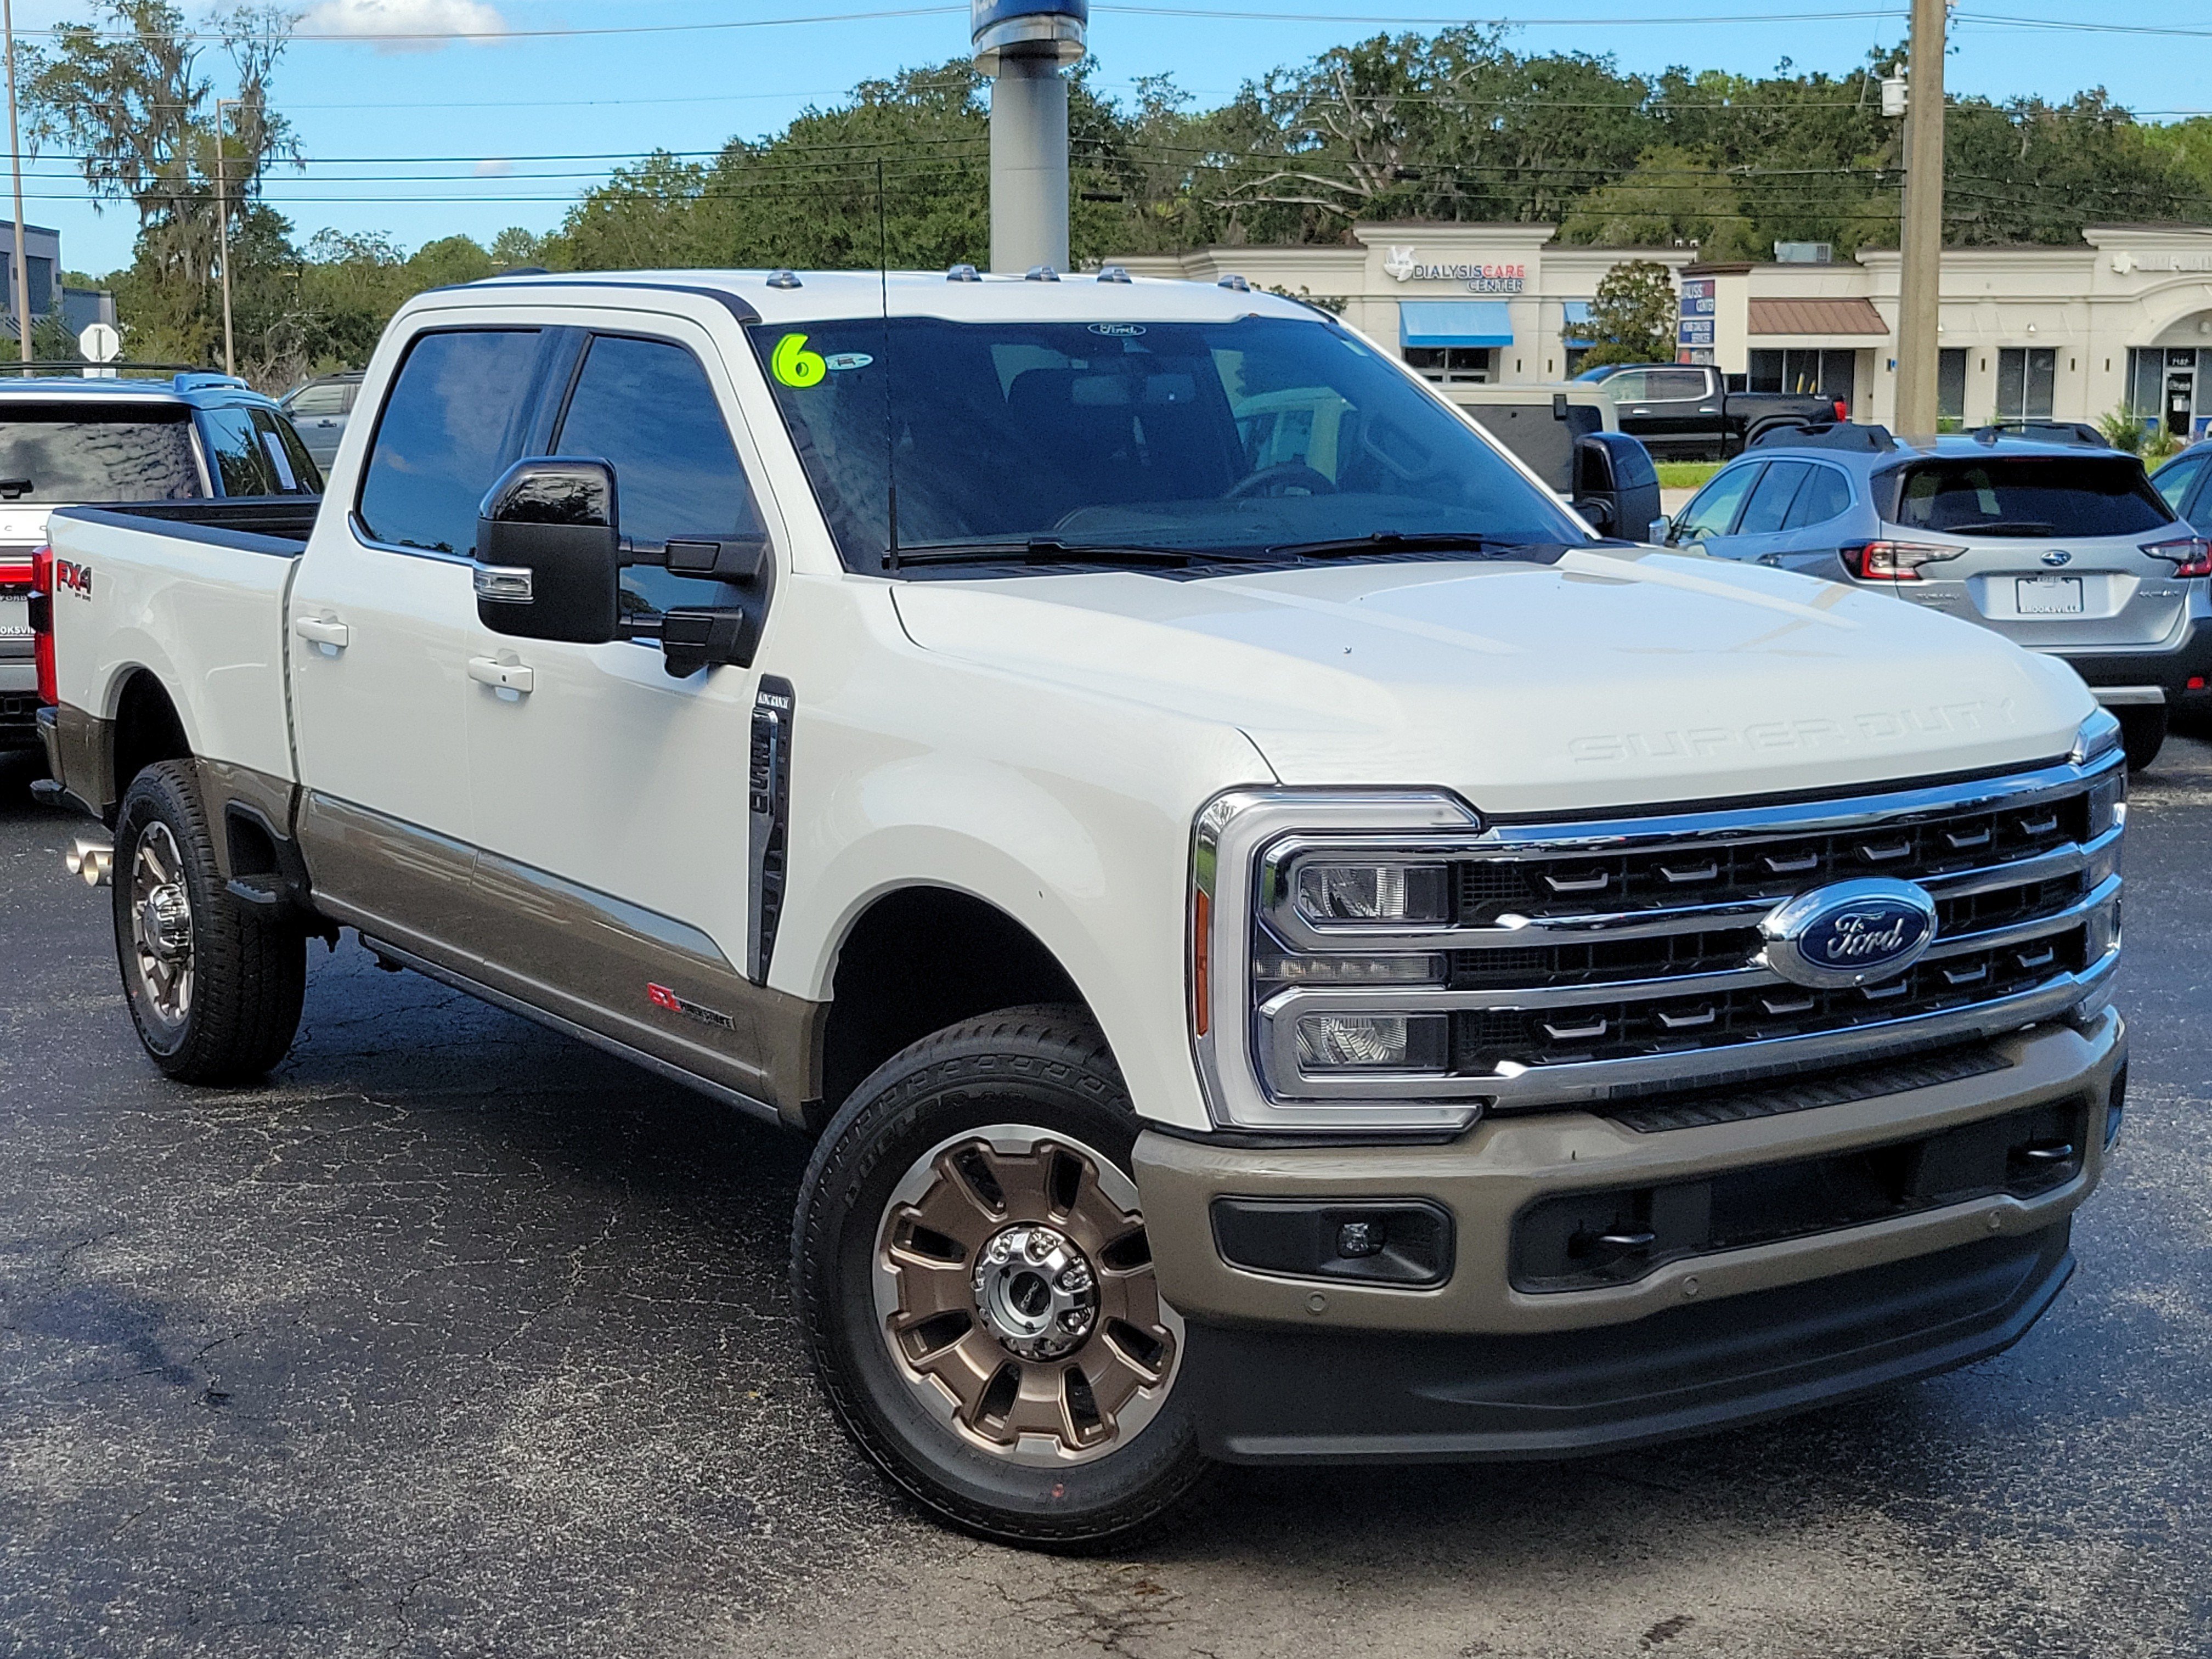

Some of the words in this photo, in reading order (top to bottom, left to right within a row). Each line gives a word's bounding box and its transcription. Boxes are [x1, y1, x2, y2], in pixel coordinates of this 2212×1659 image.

[1468, 280, 1524, 292] CENTER
[1099, 324, 1138, 334] Ford
[772, 333, 826, 388] 6
[57, 558, 92, 595] FX4
[1567, 718, 1848, 764] SUPER
[1854, 697, 2017, 741] DUTY
[1826, 911, 1904, 959] Ford
